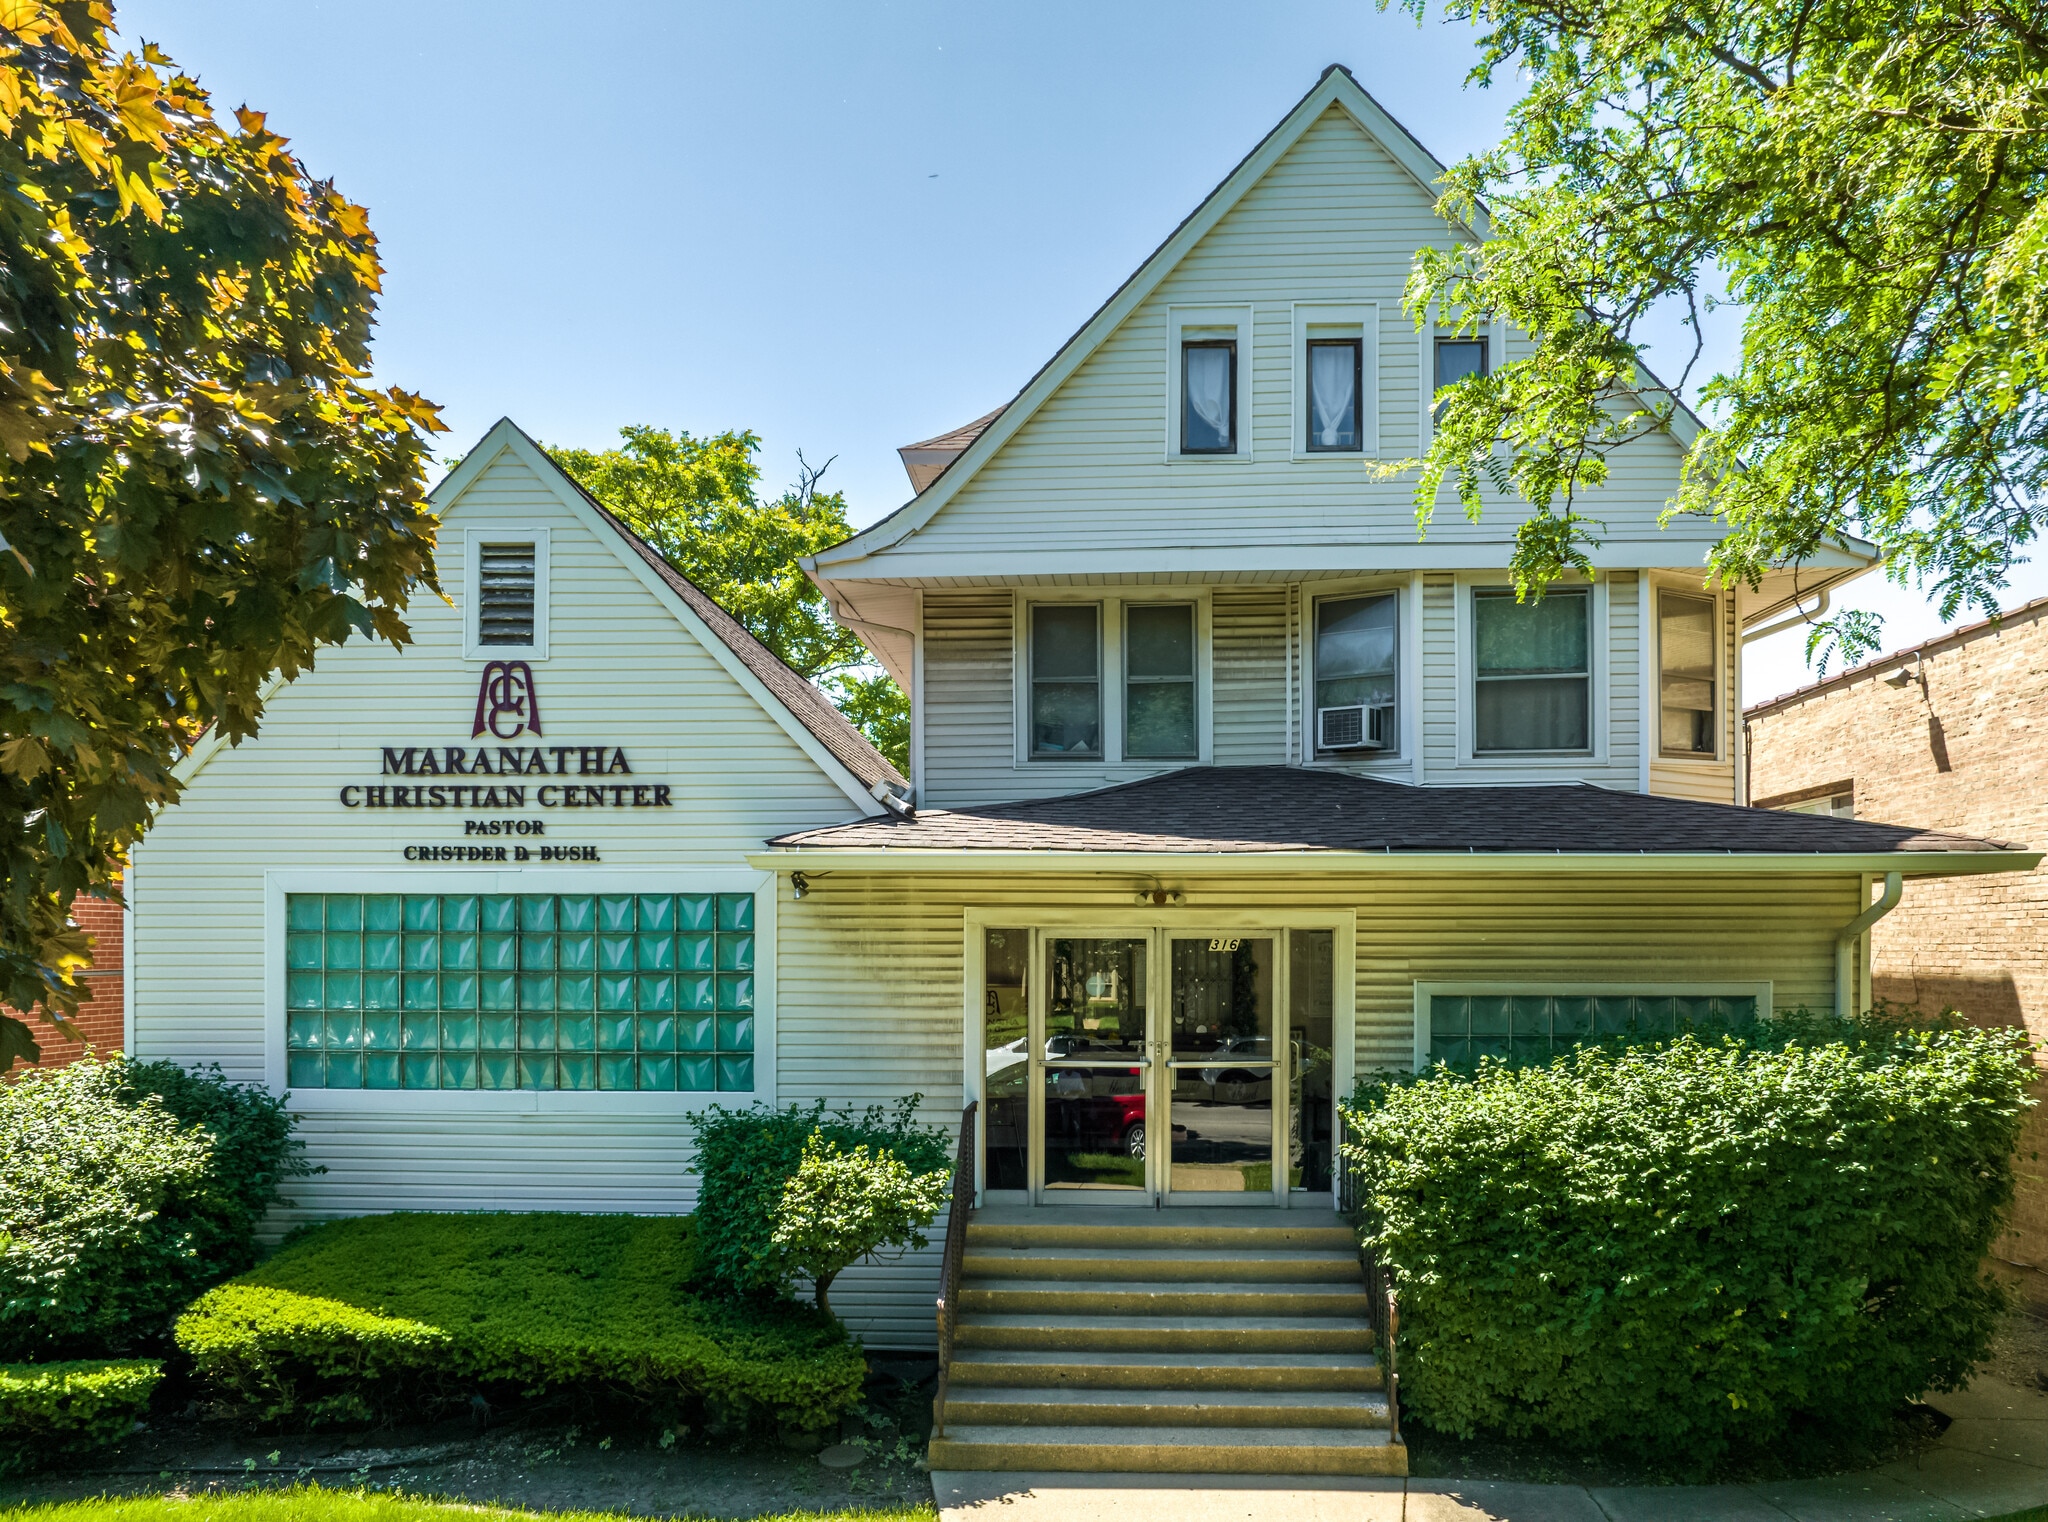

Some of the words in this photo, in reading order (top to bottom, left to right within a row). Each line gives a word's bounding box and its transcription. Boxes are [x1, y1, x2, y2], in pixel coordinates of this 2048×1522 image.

[380, 747, 633, 775] MARANATHA
[339, 786, 526, 808] CHRISTIAN
[537, 785, 673, 807] CENTER
[464, 820, 545, 836] PASTOR
[1210, 939, 1238, 950] 316
